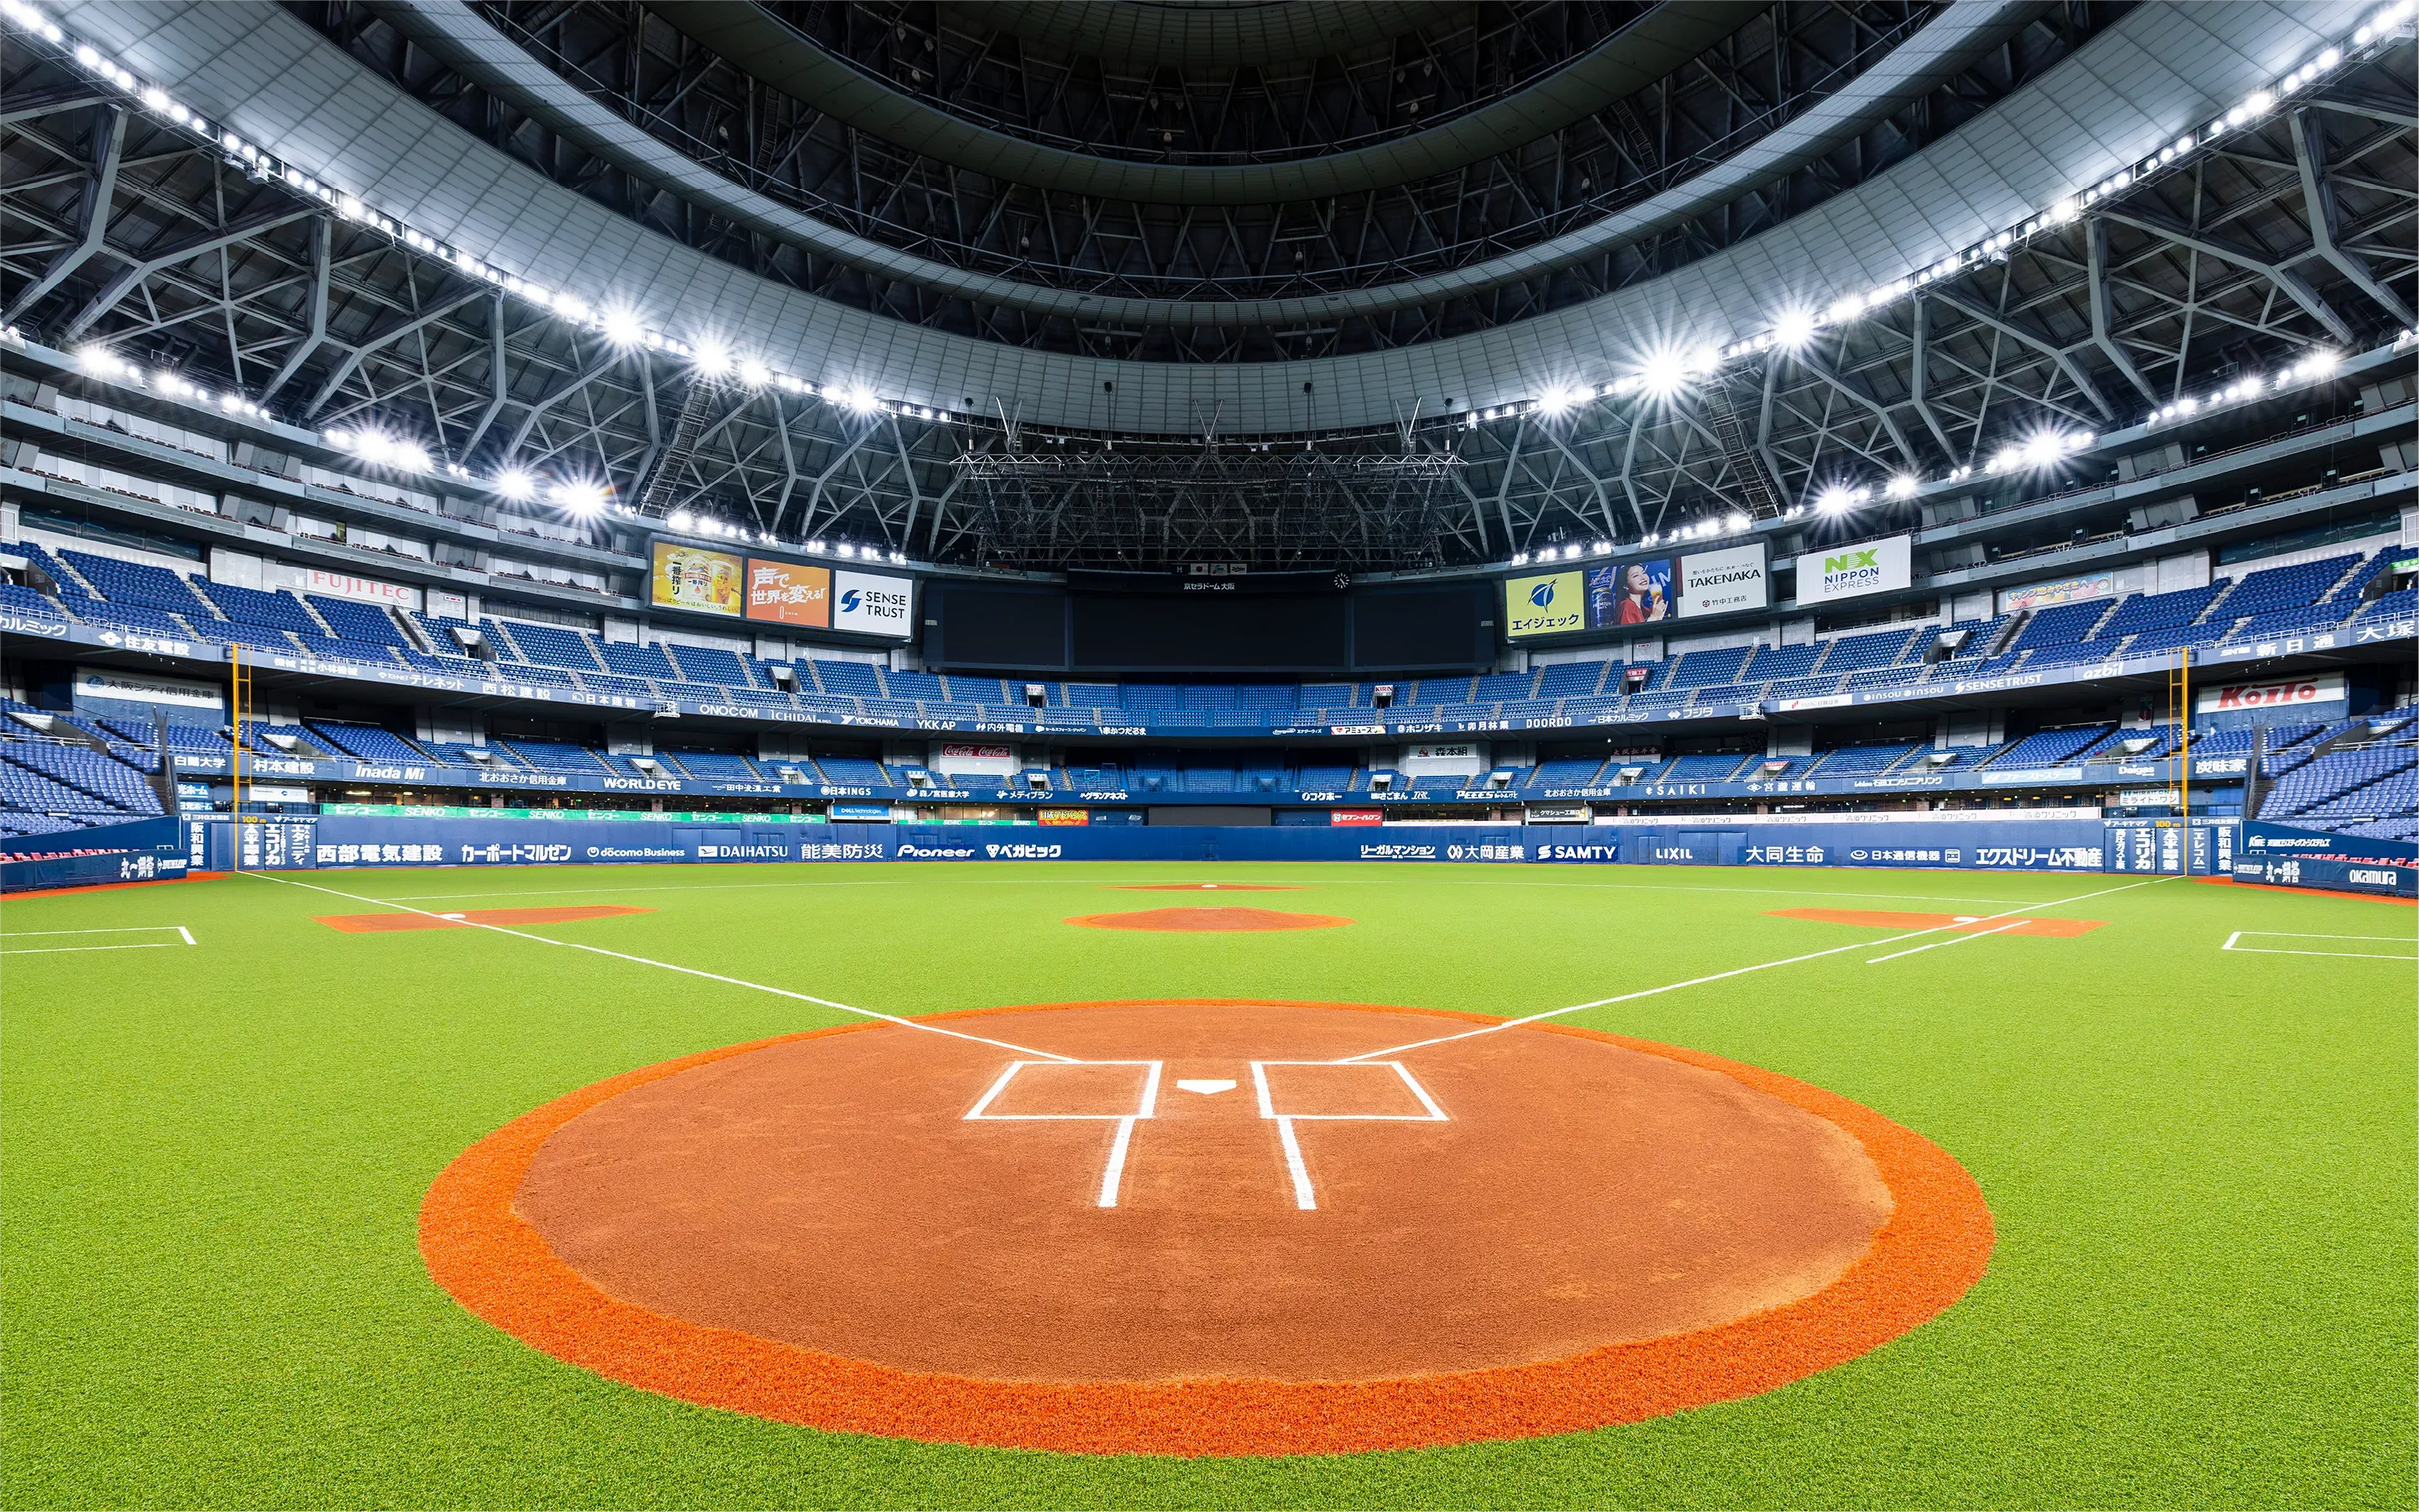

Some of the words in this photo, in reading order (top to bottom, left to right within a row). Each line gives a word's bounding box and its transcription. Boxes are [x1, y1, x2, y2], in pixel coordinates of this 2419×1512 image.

[672, 561, 682, 595] 一番搾り
[751, 568, 790, 590] 声で
[1688, 568, 1762, 589] TAKENAKA
[1825, 567, 1879, 584] NIPPON
[312, 570, 411, 601] FUJITEC
[1825, 576, 1879, 594] EXPRESS
[866, 591, 907, 606] SENSE
[1711, 595, 1747, 606] 竹中工務店
[866, 604, 905, 620] TRUST
[1511, 613, 1579, 631] エイジェック
[124, 635, 190, 657] 住友電設
[2256, 635, 2335, 657] 新日通
[2083, 662, 2124, 681] azbil
[107, 679, 215, 700] 大阪シティ信用金庫
[409, 674, 465, 691] テレネット
[482, 683, 552, 701] 西松建設
[586, 693, 636, 708] 日本建物
[699, 704, 758, 719] ONOCOM
[1597, 712, 1649, 725] 日本カルミック
[1683, 707, 1713, 718] フジタ
[855, 716, 899, 727] YOKOHAMA
[916, 719, 939, 730] YKK
[940, 720, 956, 730] AP
[987, 723, 1024, 733] 内外電機
[1406, 724, 1443, 733] ホシザキ
[1526, 716, 1573, 729] DOORDO
[1435, 746, 1469, 757] 森本組
[253, 758, 316, 775] 村本建設
[355, 765, 401, 780] Inada
[404, 767, 425, 781] Mi
[2196, 758, 2247, 774] 炭味家
[479, 772, 568, 787] 北おおさか信用金庫
[1544, 787, 1612, 798] 北おおさか信用金庫
[1657, 783, 1706, 796] SAIKI
[334, 804, 380, 816] センコー
[404, 807, 446, 818] SENKO
[469, 808, 505, 819] センコー
[528, 809, 565, 820] SENKO
[640, 812, 673, 822] SENKO
[741, 814, 772, 823] SENKO
[191, 822, 204, 866] 阪和興業
[264, 824, 280, 866] エコリカ
[291, 824, 306, 866] エタニティ
[600, 846, 644, 857] docomo
[645, 846, 685, 857] Business
[720, 845, 788, 857] DAIHATSU
[801, 843, 884, 860] 能美防災
[897, 844, 976, 858] Pioneer
[1360, 845, 1436, 856] リーガルマンション
[1555, 845, 1617, 859] SAMTY
[2134, 828, 2151, 870] エコリカ
[2217, 826, 2232, 871] 阪和興業
[317, 844, 443, 863] 西部電気建設
[462, 844, 572, 862] カーポートマルゼン
[1465, 845, 1525, 860] 大岡産業
[1656, 848, 1694, 860] LIXIL
[1746, 845, 1825, 863] 大同生命
[1872, 850, 1940, 861] 日本通信機器
[1976, 848, 2103, 867] エクスドリーム不動産
